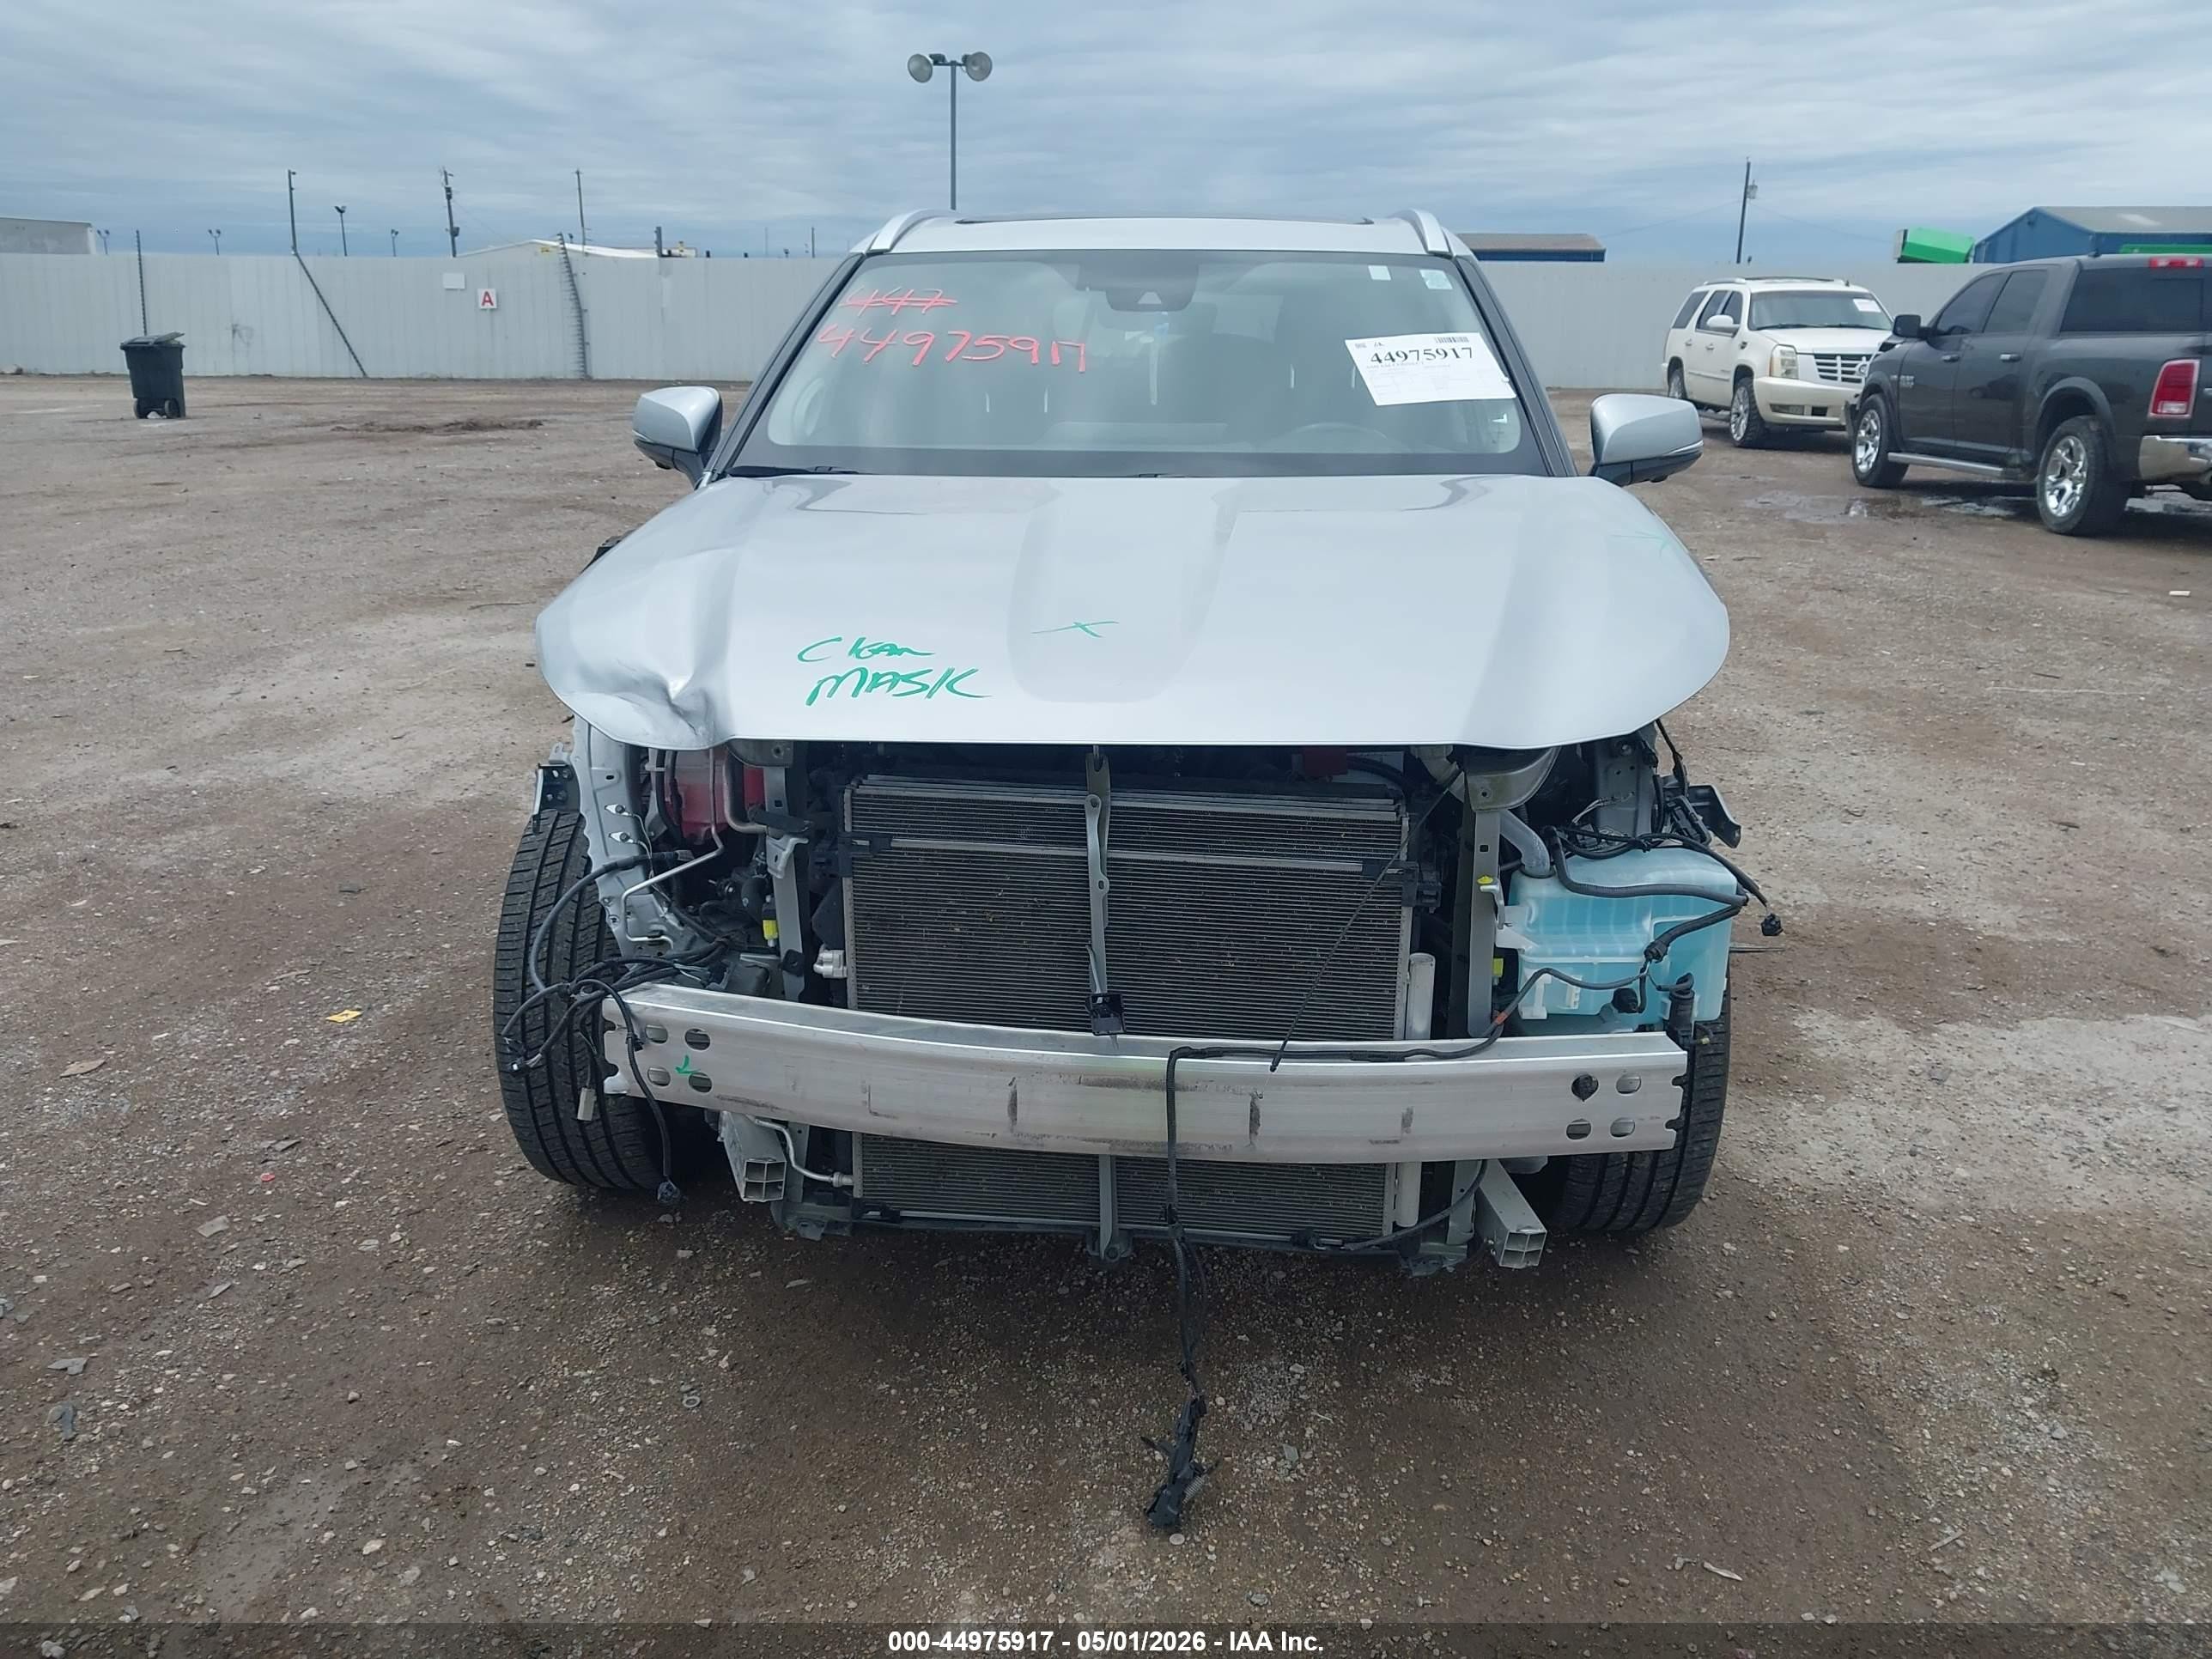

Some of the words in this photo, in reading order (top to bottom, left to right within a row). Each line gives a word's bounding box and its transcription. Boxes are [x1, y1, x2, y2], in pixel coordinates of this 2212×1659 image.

[481, 290, 494, 307] A
[1370, 347, 1473, 363] 44975917
[805, 666, 993, 706] MASK
